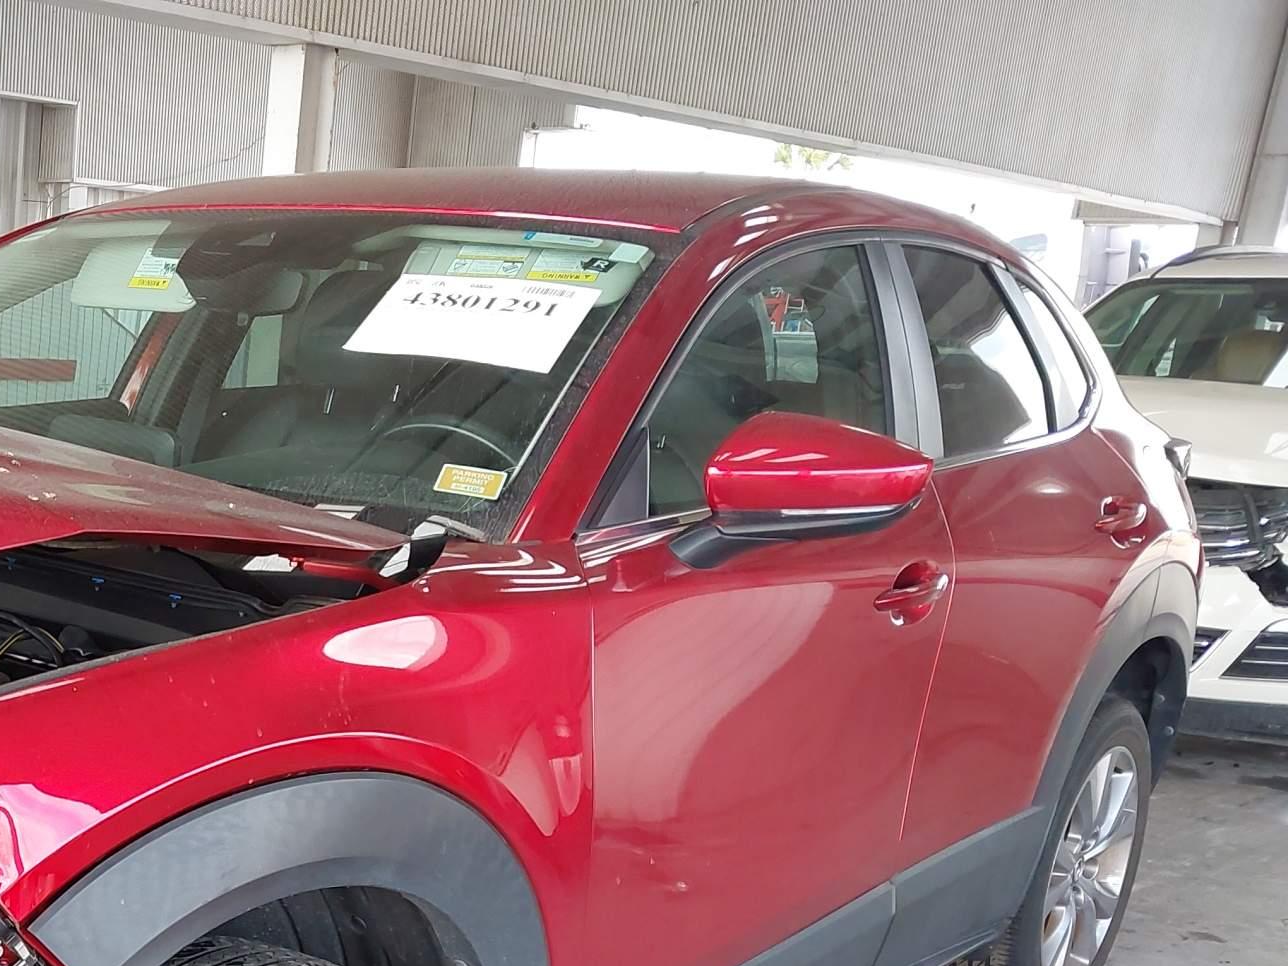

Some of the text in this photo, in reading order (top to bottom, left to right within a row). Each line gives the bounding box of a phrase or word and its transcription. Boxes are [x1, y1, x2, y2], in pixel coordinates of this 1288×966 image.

[403, 291, 558, 316] 43801291
[451, 469, 495, 480] PARKING
[452, 475, 488, 485] PERMIT
